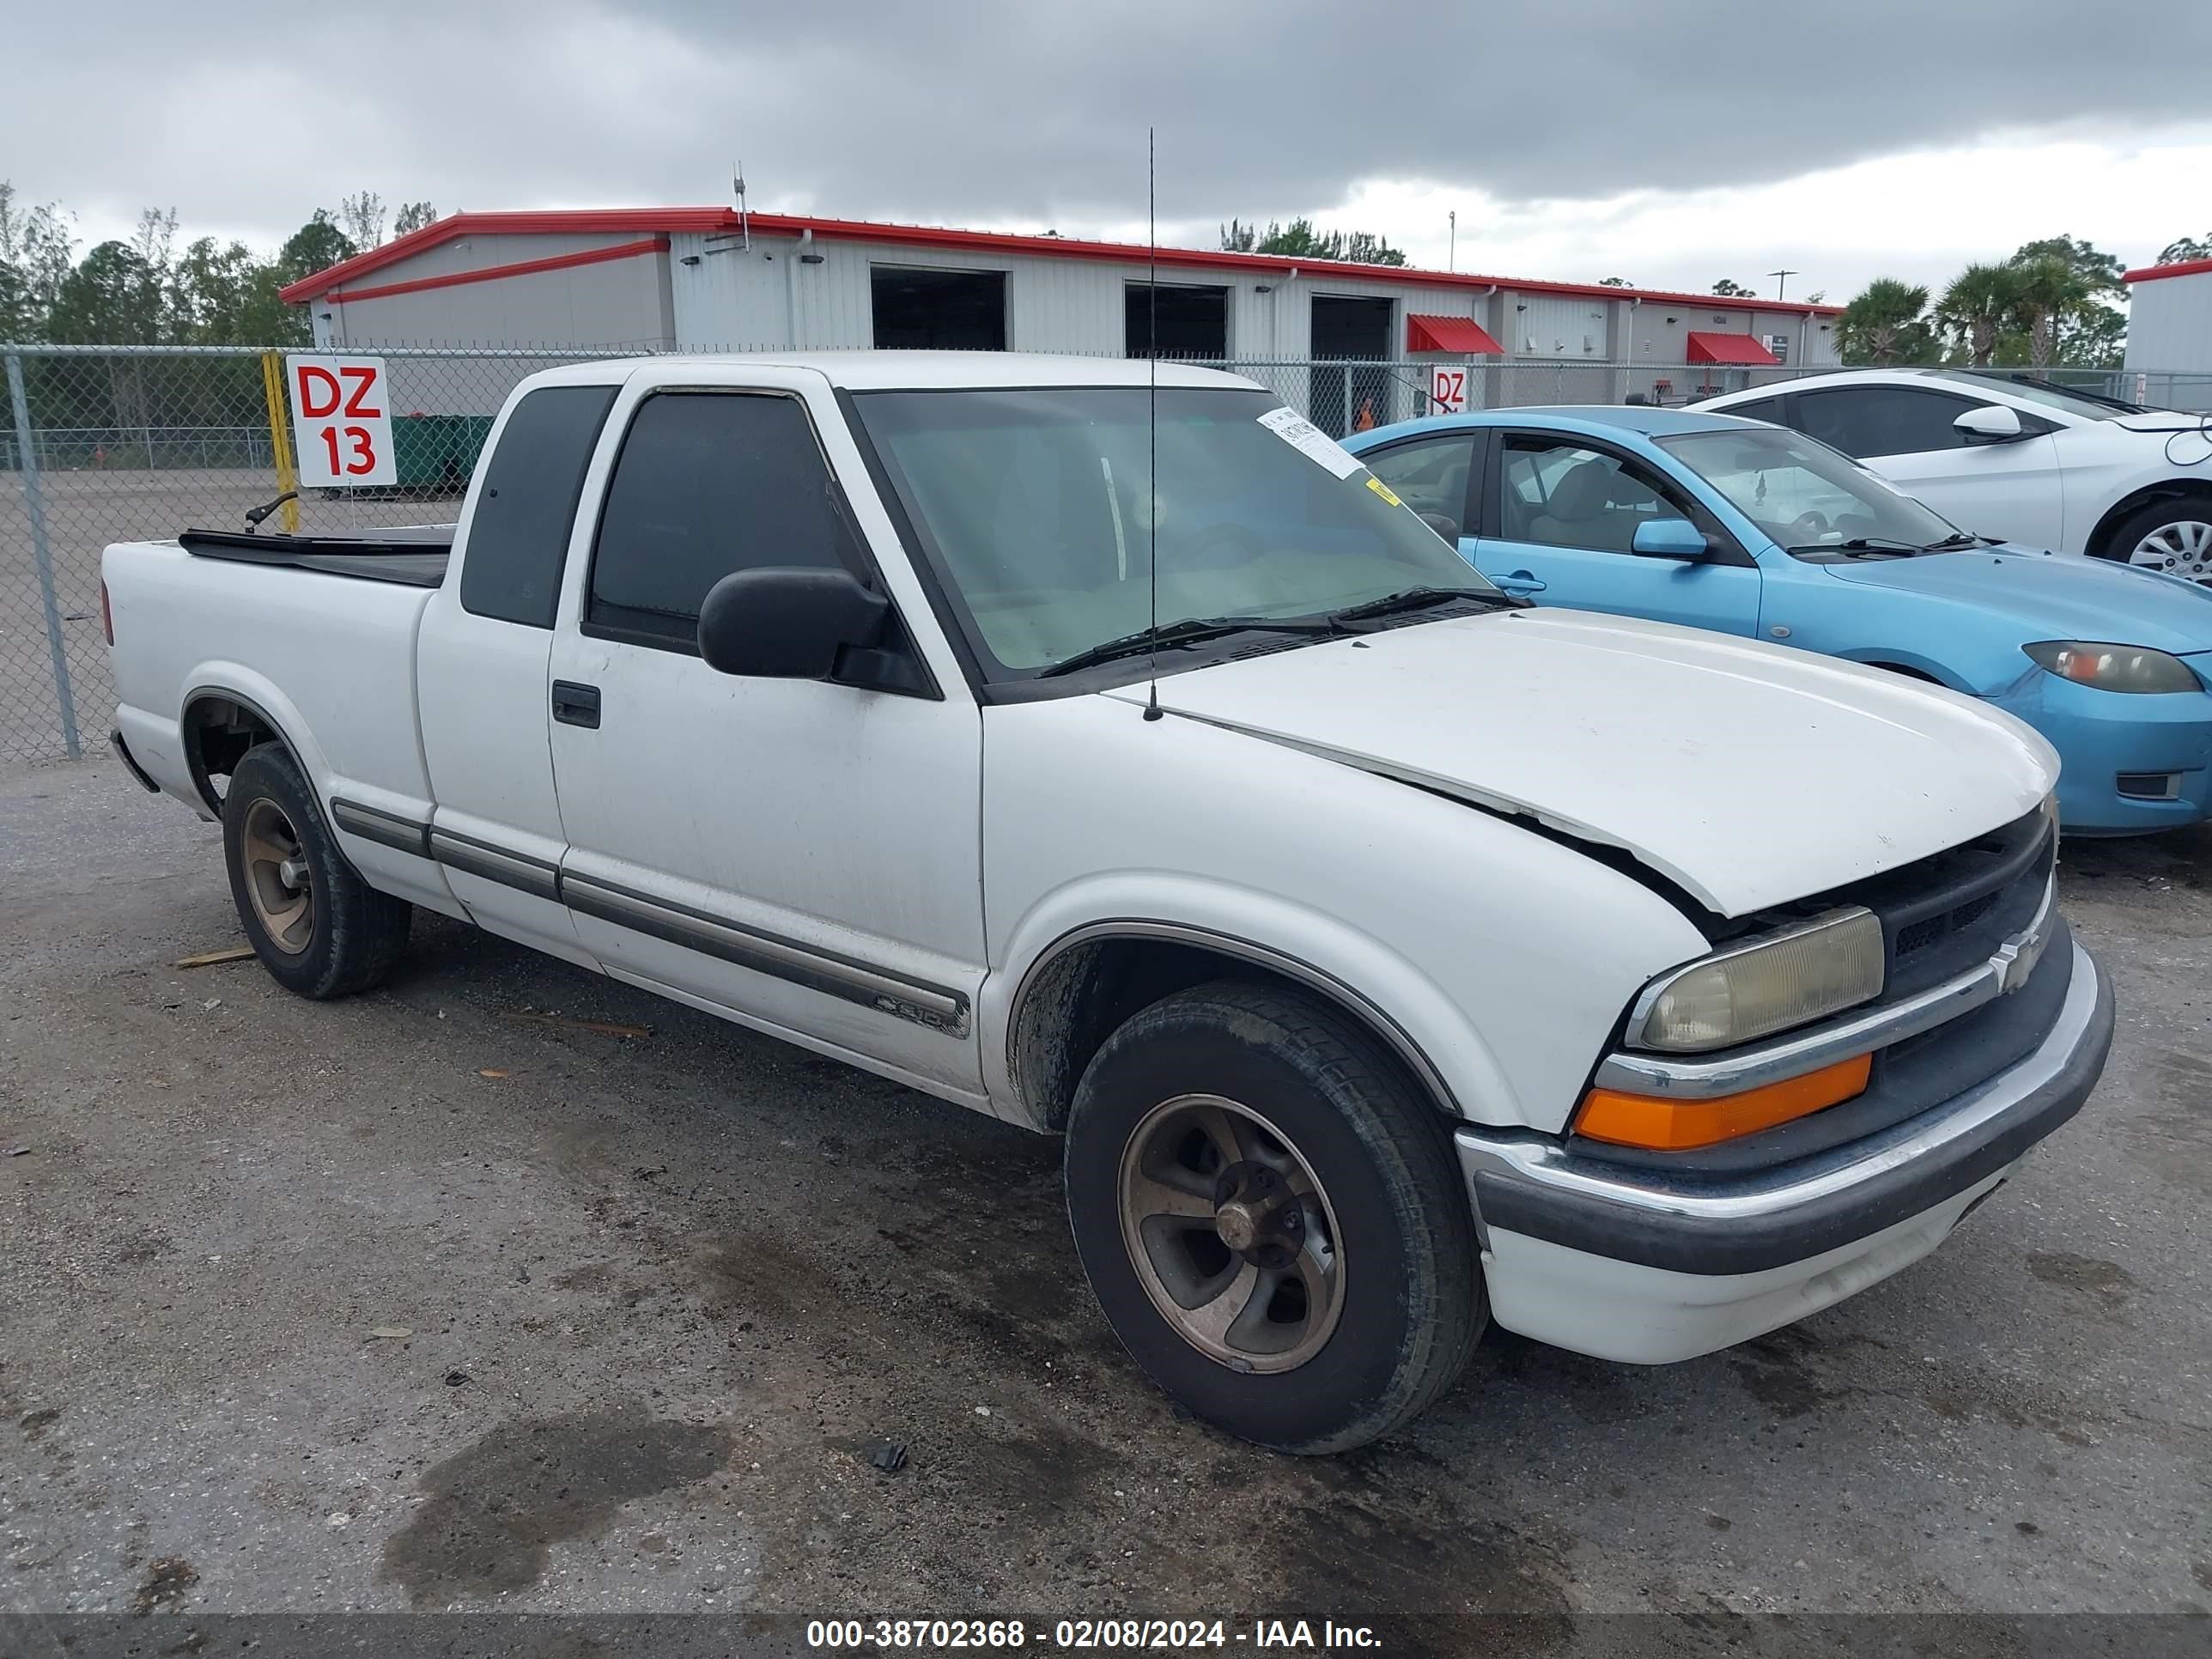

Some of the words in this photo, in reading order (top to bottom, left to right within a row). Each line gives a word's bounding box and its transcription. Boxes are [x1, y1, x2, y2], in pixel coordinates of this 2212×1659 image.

[297, 366, 381, 419] DZ
[1437, 373, 1464, 403] DZ
[320, 426, 376, 476] 13
